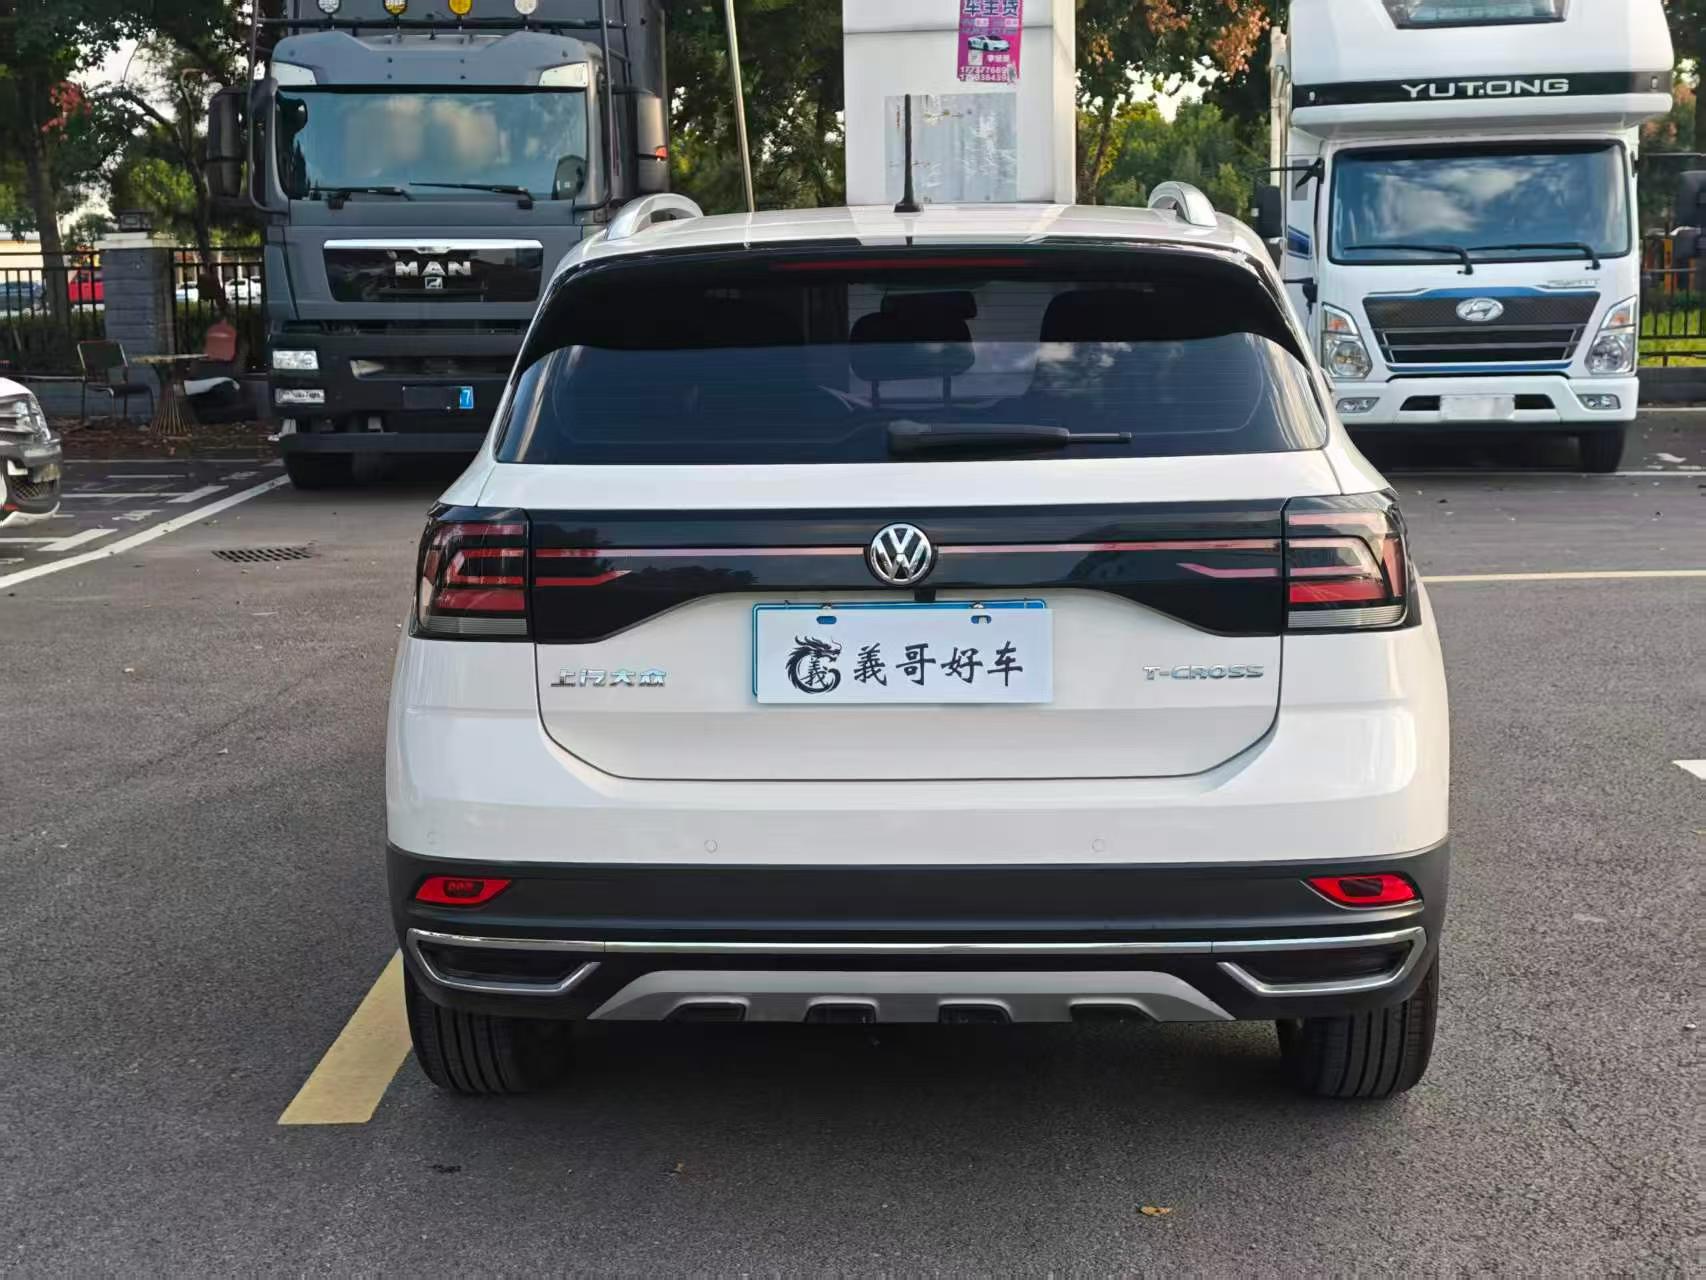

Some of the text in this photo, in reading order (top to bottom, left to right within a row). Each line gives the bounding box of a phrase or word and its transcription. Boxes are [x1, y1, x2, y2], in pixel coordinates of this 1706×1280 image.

[1401, 78, 1569, 98] YUTONG
[395, 261, 471, 276] MAN
[853, 640, 1024, 688] 義哥好车
[1142, 664, 1265, 680] T-CROSS
[550, 667, 667, 687] 上汽大众
